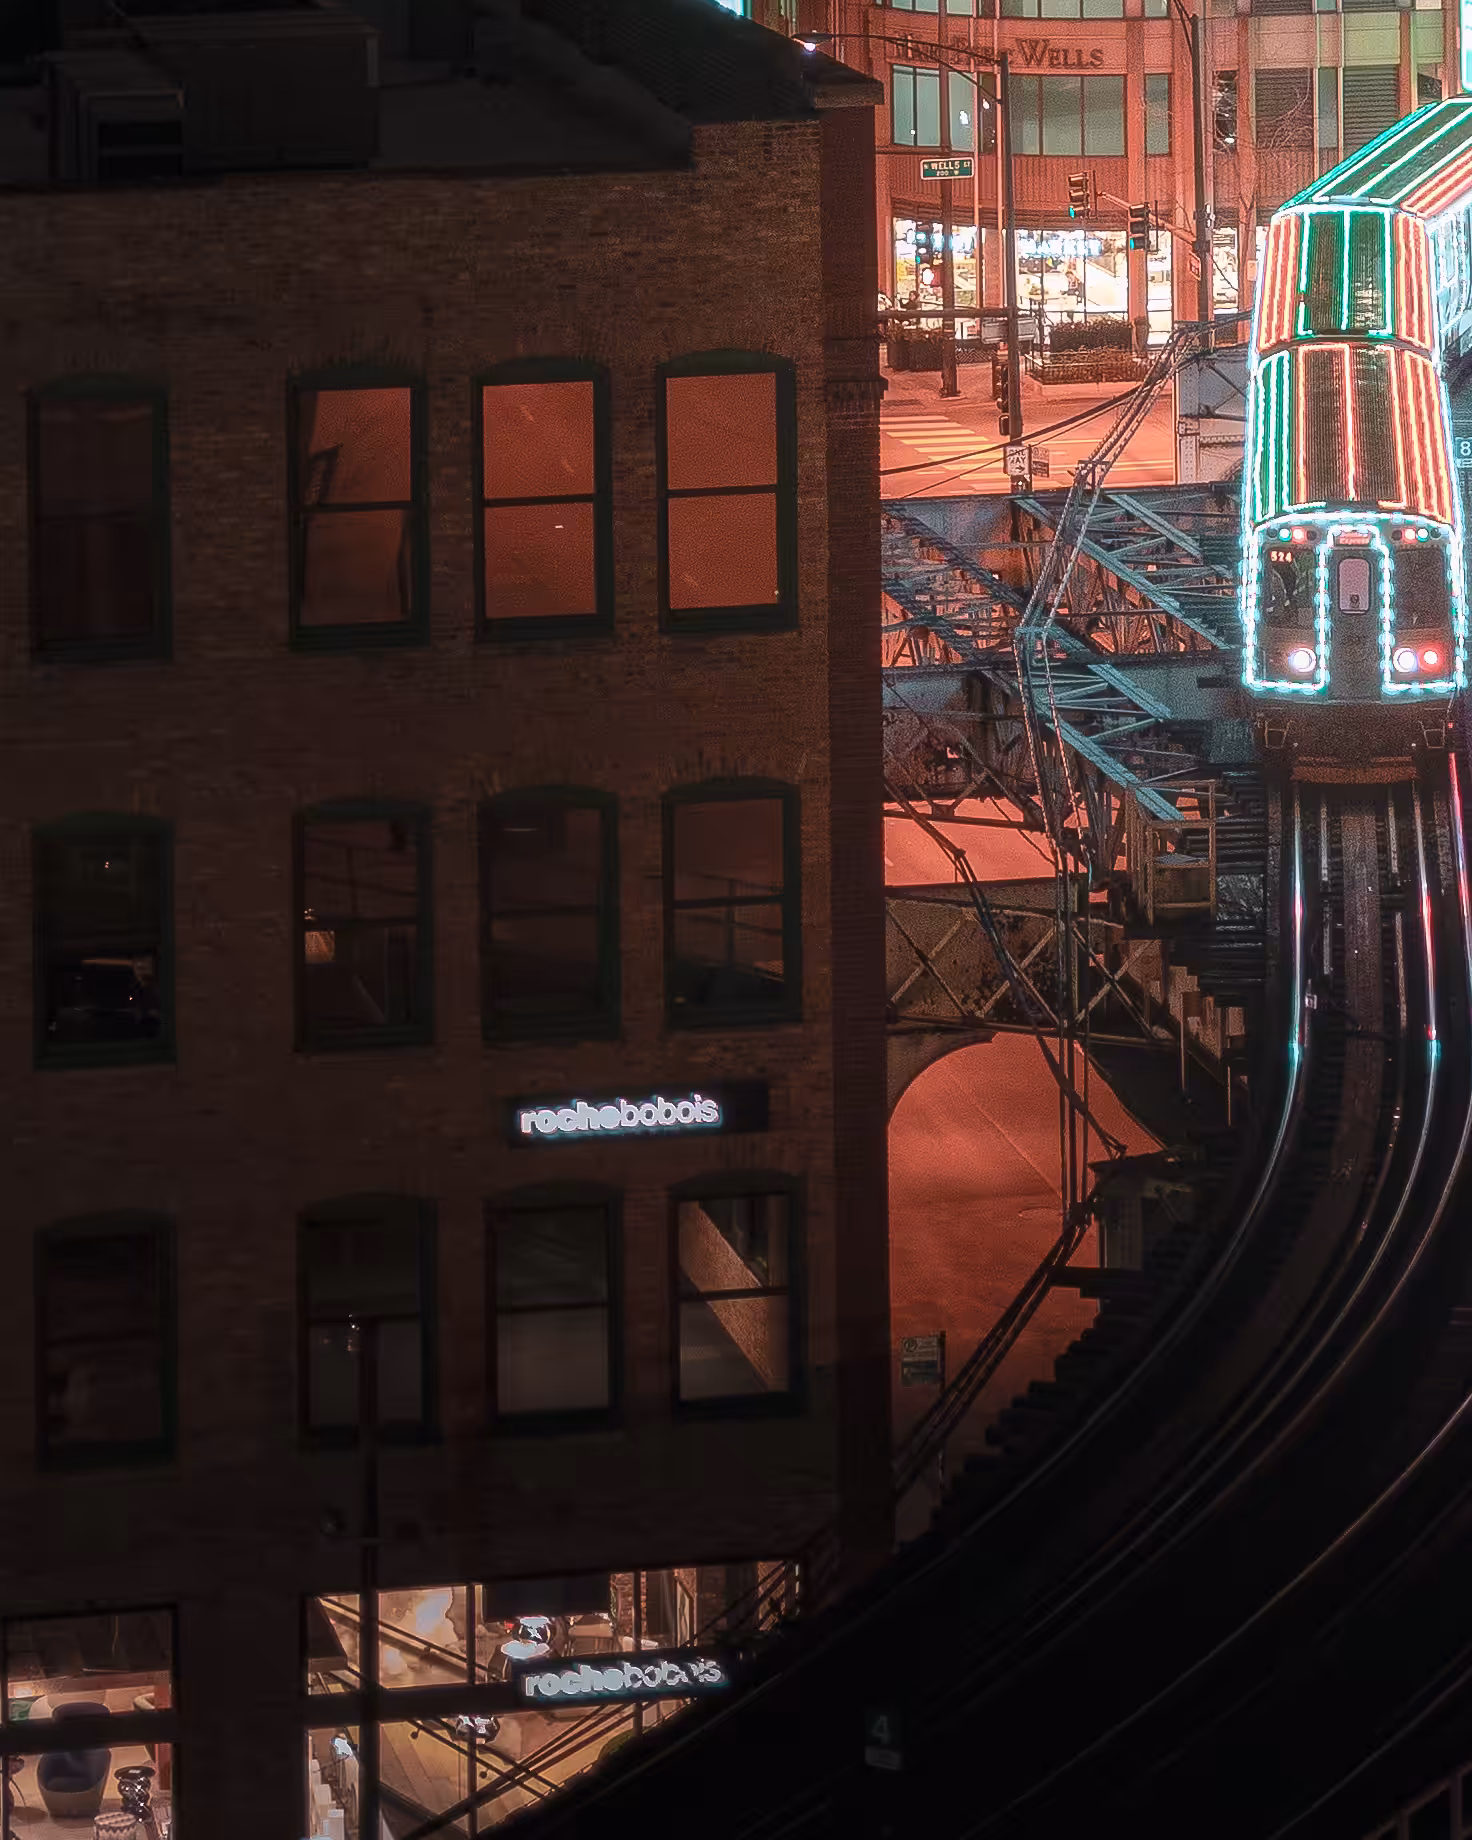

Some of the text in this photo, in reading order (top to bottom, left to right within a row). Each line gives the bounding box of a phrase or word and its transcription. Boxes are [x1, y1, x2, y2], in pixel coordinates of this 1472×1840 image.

[1015, 39, 1103, 69] WELLS
[931, 161, 960, 170] WELLS
[1460, 441, 1472, 456] 8
[1270, 549, 1293, 563] 524
